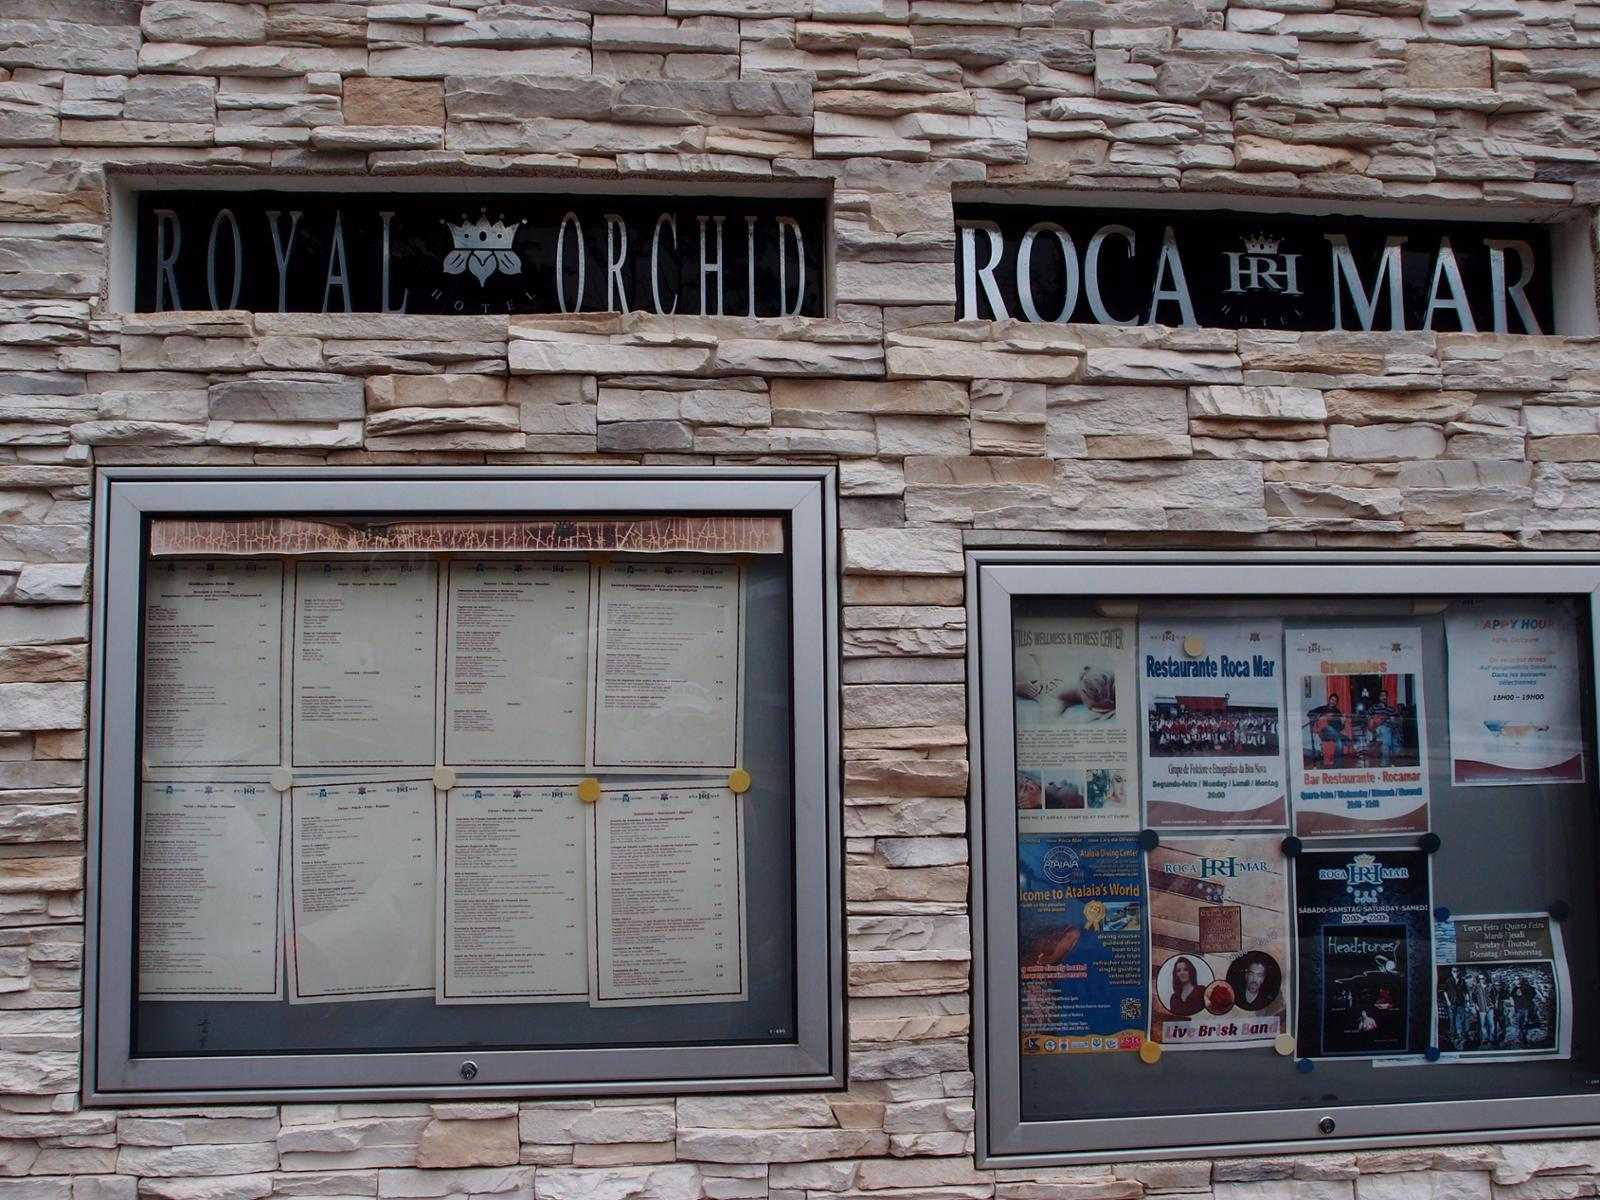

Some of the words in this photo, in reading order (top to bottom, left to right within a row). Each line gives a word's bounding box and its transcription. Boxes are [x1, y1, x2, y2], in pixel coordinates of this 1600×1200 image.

[154, 208, 407, 314] ROYAL
[556, 211, 806, 317] ORCHID
[955, 219, 1203, 328] ROCA
[1323, 233, 1545, 336] MAR
[1073, 631, 1099, 647] FITNESS
[1146, 654, 1218, 678] Restaurante
[1220, 655, 1250, 678] Roca
[1252, 655, 1275, 678] Mar
[1522, 693, 1545, 701] 19H00
[1202, 780, 1228, 789] Monday
[1232, 779, 1250, 788] Lundi
[1254, 779, 1279, 788] Montag
[1304, 773, 1320, 786] Bar
[1322, 771, 1375, 785] Restaurante
[1383, 770, 1421, 783] Rocamar
[1207, 791, 1226, 799] 20:00
[1101, 849, 1119, 859] Diving
[1120, 848, 1138, 857] Center
[1164, 862, 1198, 874] ROCA
[1240, 861, 1269, 872] MAR
[1318, 869, 1348, 880] ROCA
[1381, 868, 1409, 879] MAR
[1052, 888, 1063, 899] to
[1065, 883, 1108, 899] Atalaia's
[1109, 881, 1140, 897] World
[1462, 923, 1482, 932] Terça
[1475, 941, 1501, 951] Tuesday
[1506, 939, 1537, 949] Thursday
[1470, 951, 1499, 959] Dienstag
[1504, 949, 1543, 958] Donnerstag
[1198, 1022, 1238, 1038] Brisk
